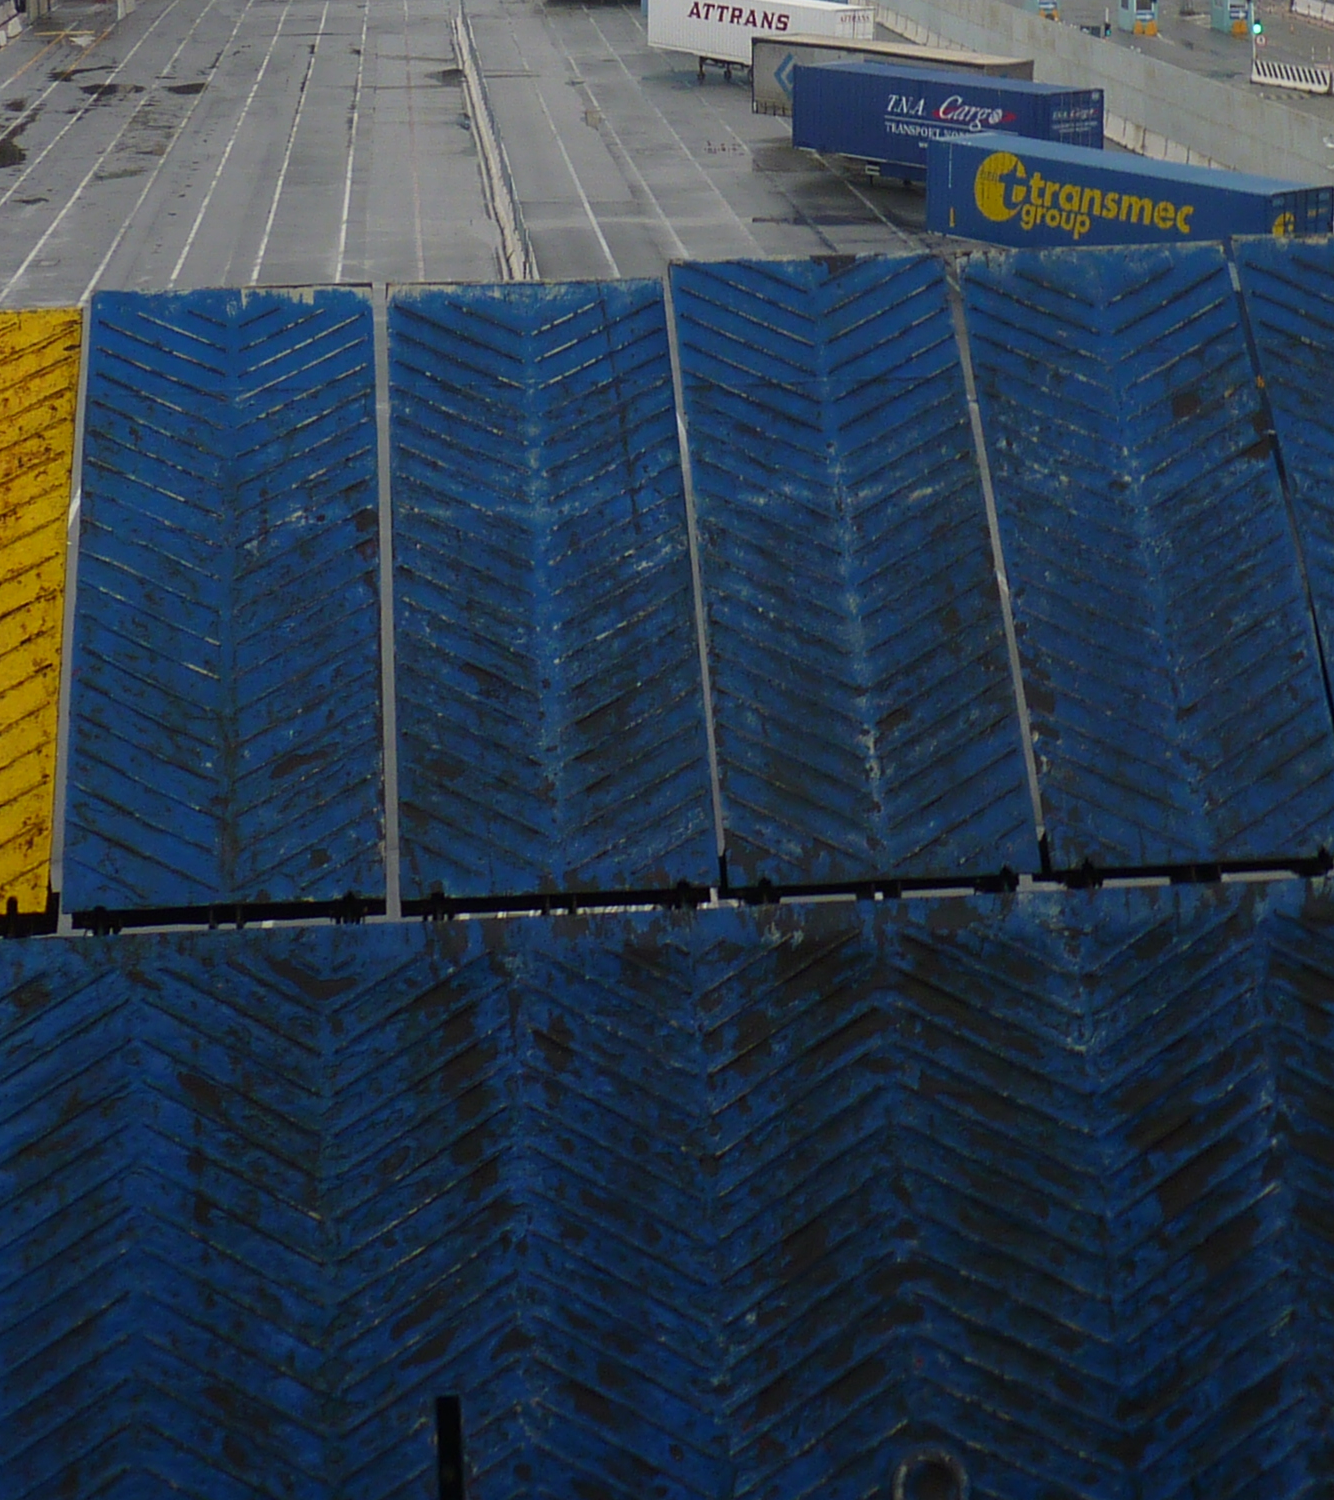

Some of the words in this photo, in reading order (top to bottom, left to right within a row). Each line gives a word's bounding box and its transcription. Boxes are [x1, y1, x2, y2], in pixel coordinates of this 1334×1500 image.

[687, 0, 790, 32] ATTRANS
[938, 95, 1003, 131] Cargo
[1021, 197, 1091, 240] group
[1029, 171, 1194, 233] transmec
